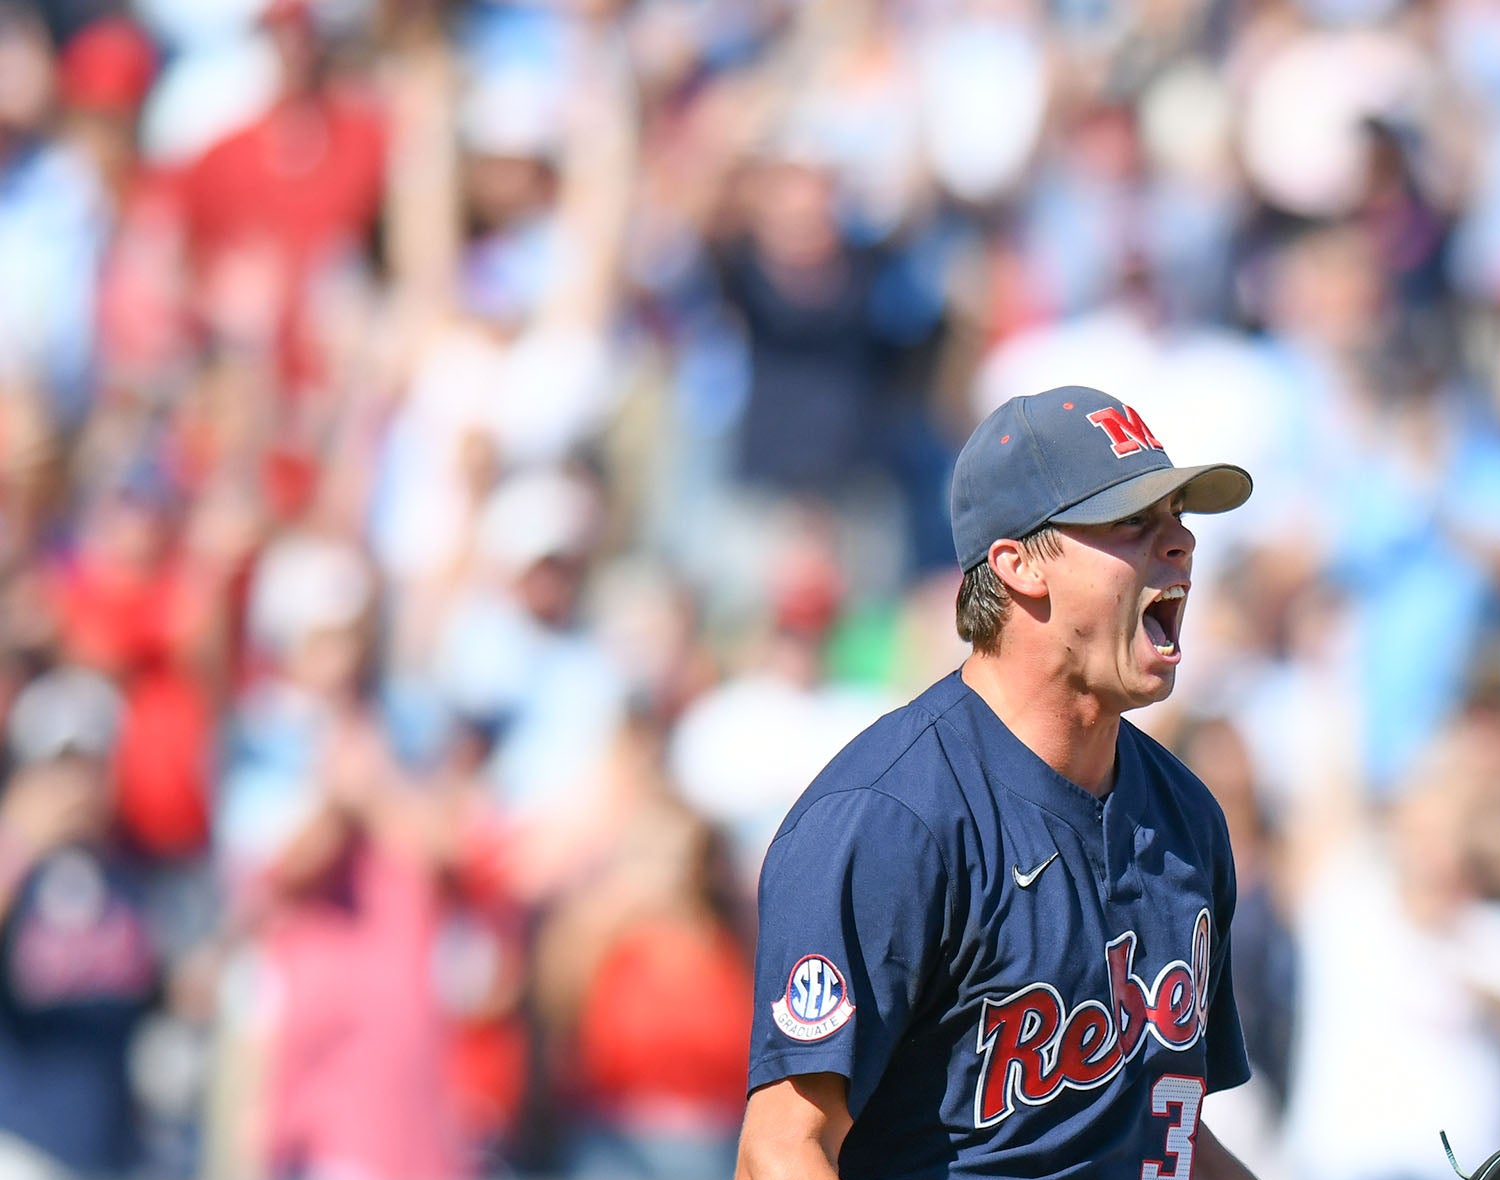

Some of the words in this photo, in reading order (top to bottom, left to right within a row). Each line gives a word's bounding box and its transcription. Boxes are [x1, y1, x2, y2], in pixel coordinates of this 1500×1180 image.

[1086, 404, 1165, 459] M
[791, 959, 839, 1019] SEC
[778, 1012, 840, 1038] GRADUATE
